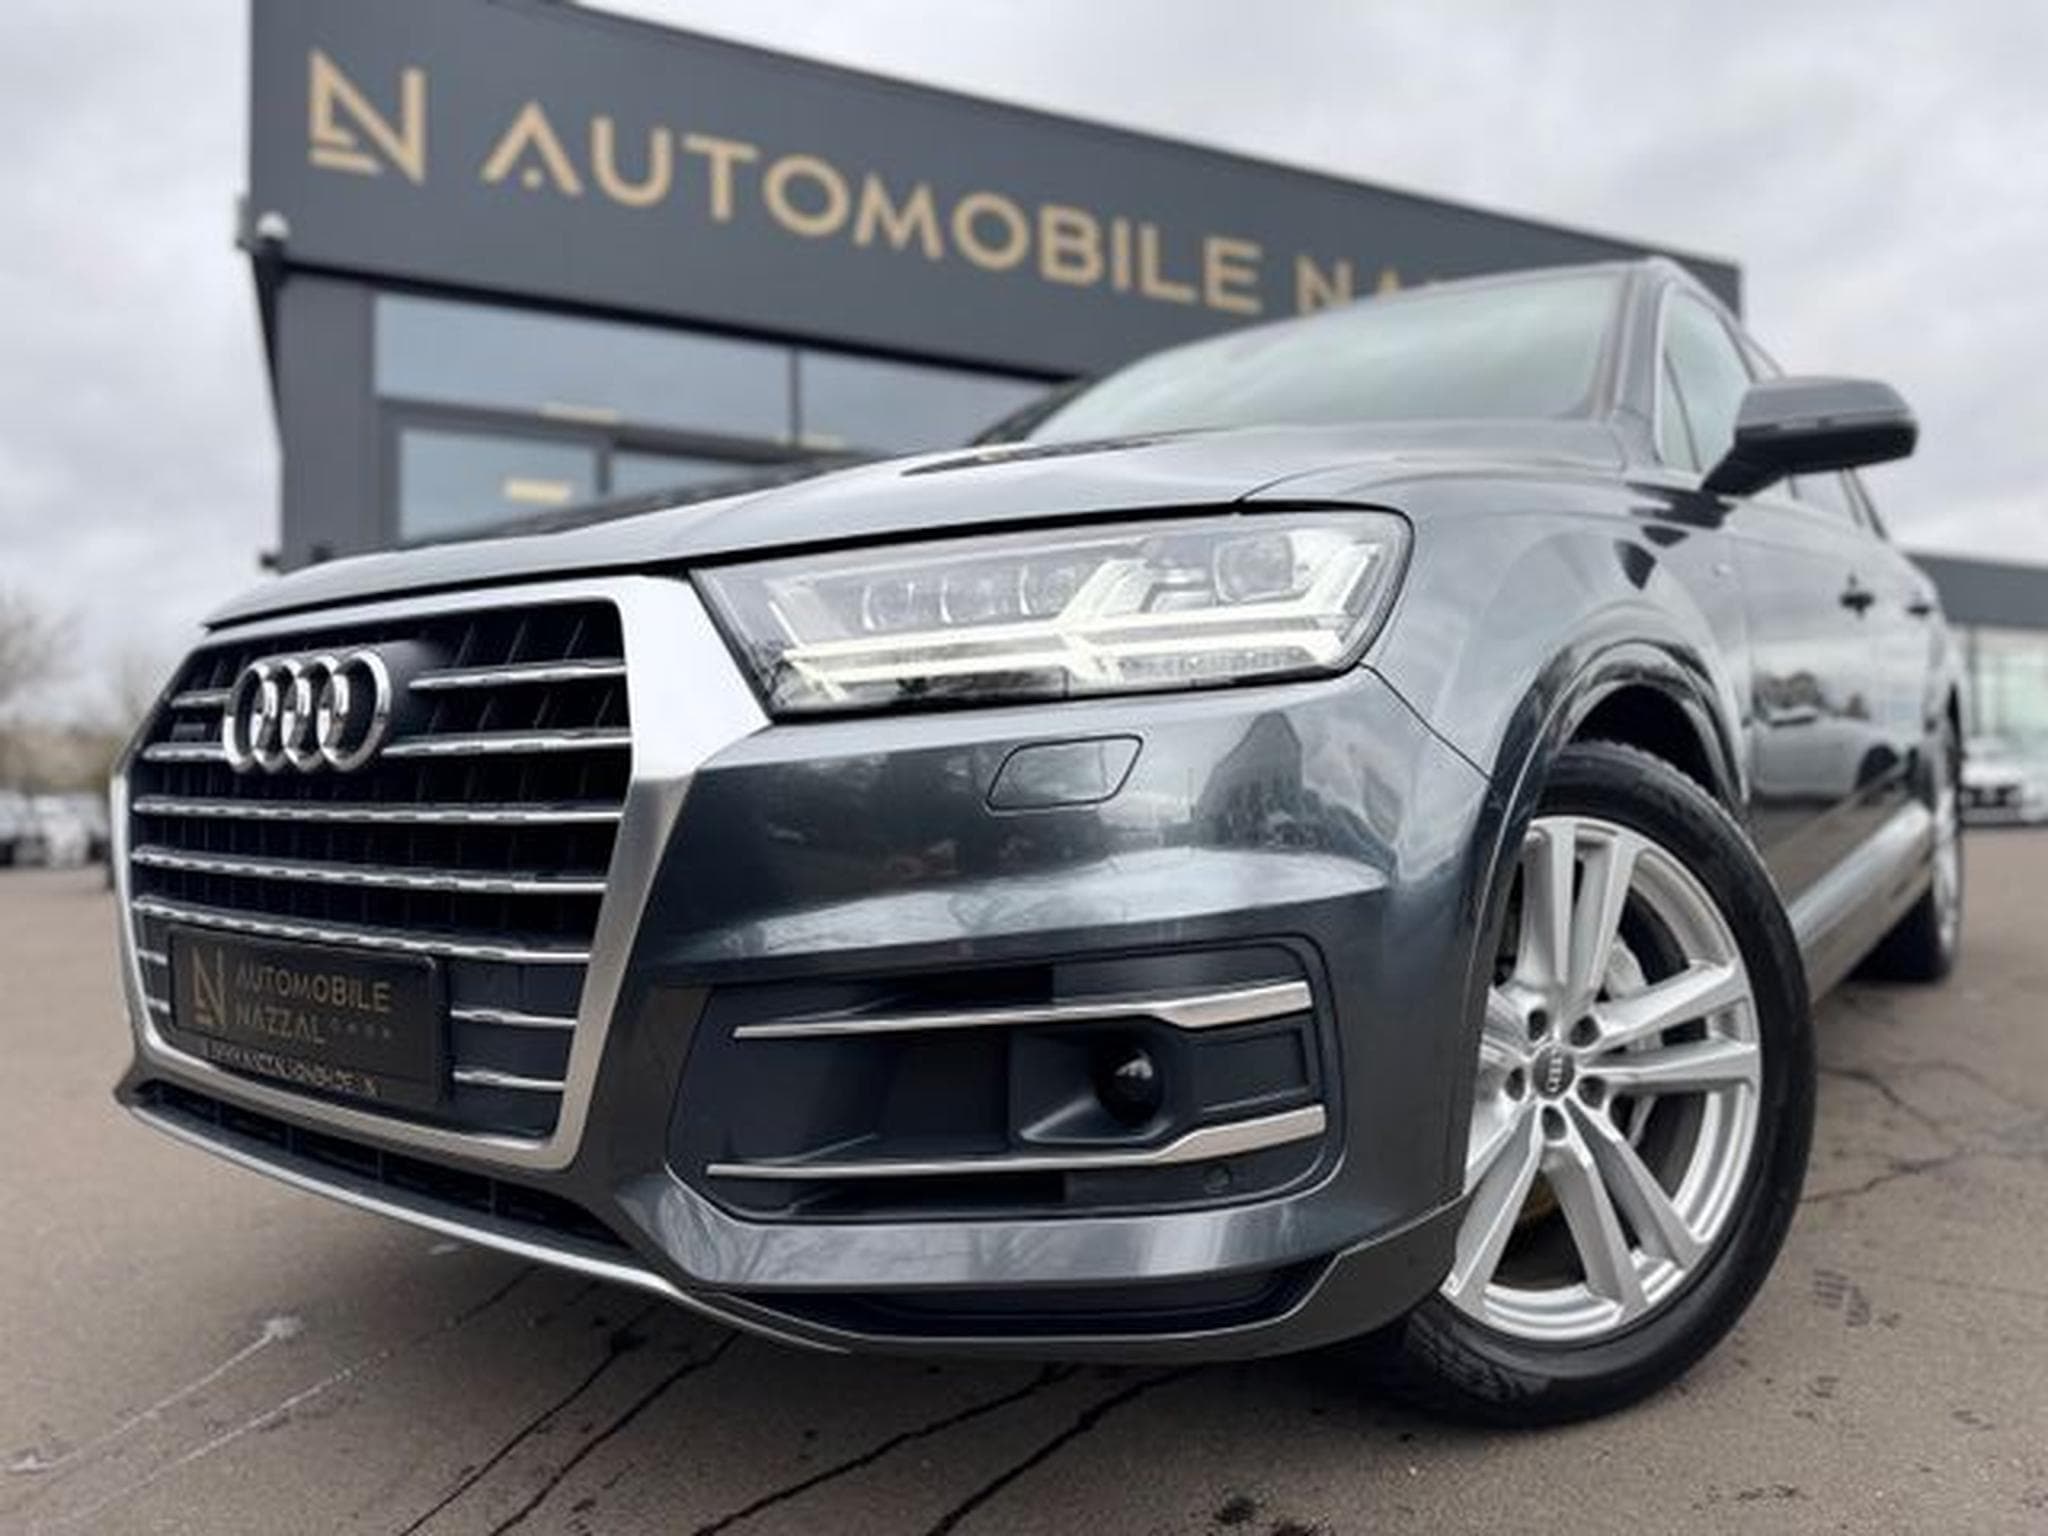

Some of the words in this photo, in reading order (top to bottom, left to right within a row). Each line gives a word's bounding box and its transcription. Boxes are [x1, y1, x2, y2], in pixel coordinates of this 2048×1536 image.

[481, 101, 1263, 315] AUTOMOBILE
[234, 961, 392, 1012] AUTOMOBILE
[235, 1002, 326, 1045] NAZZAL
